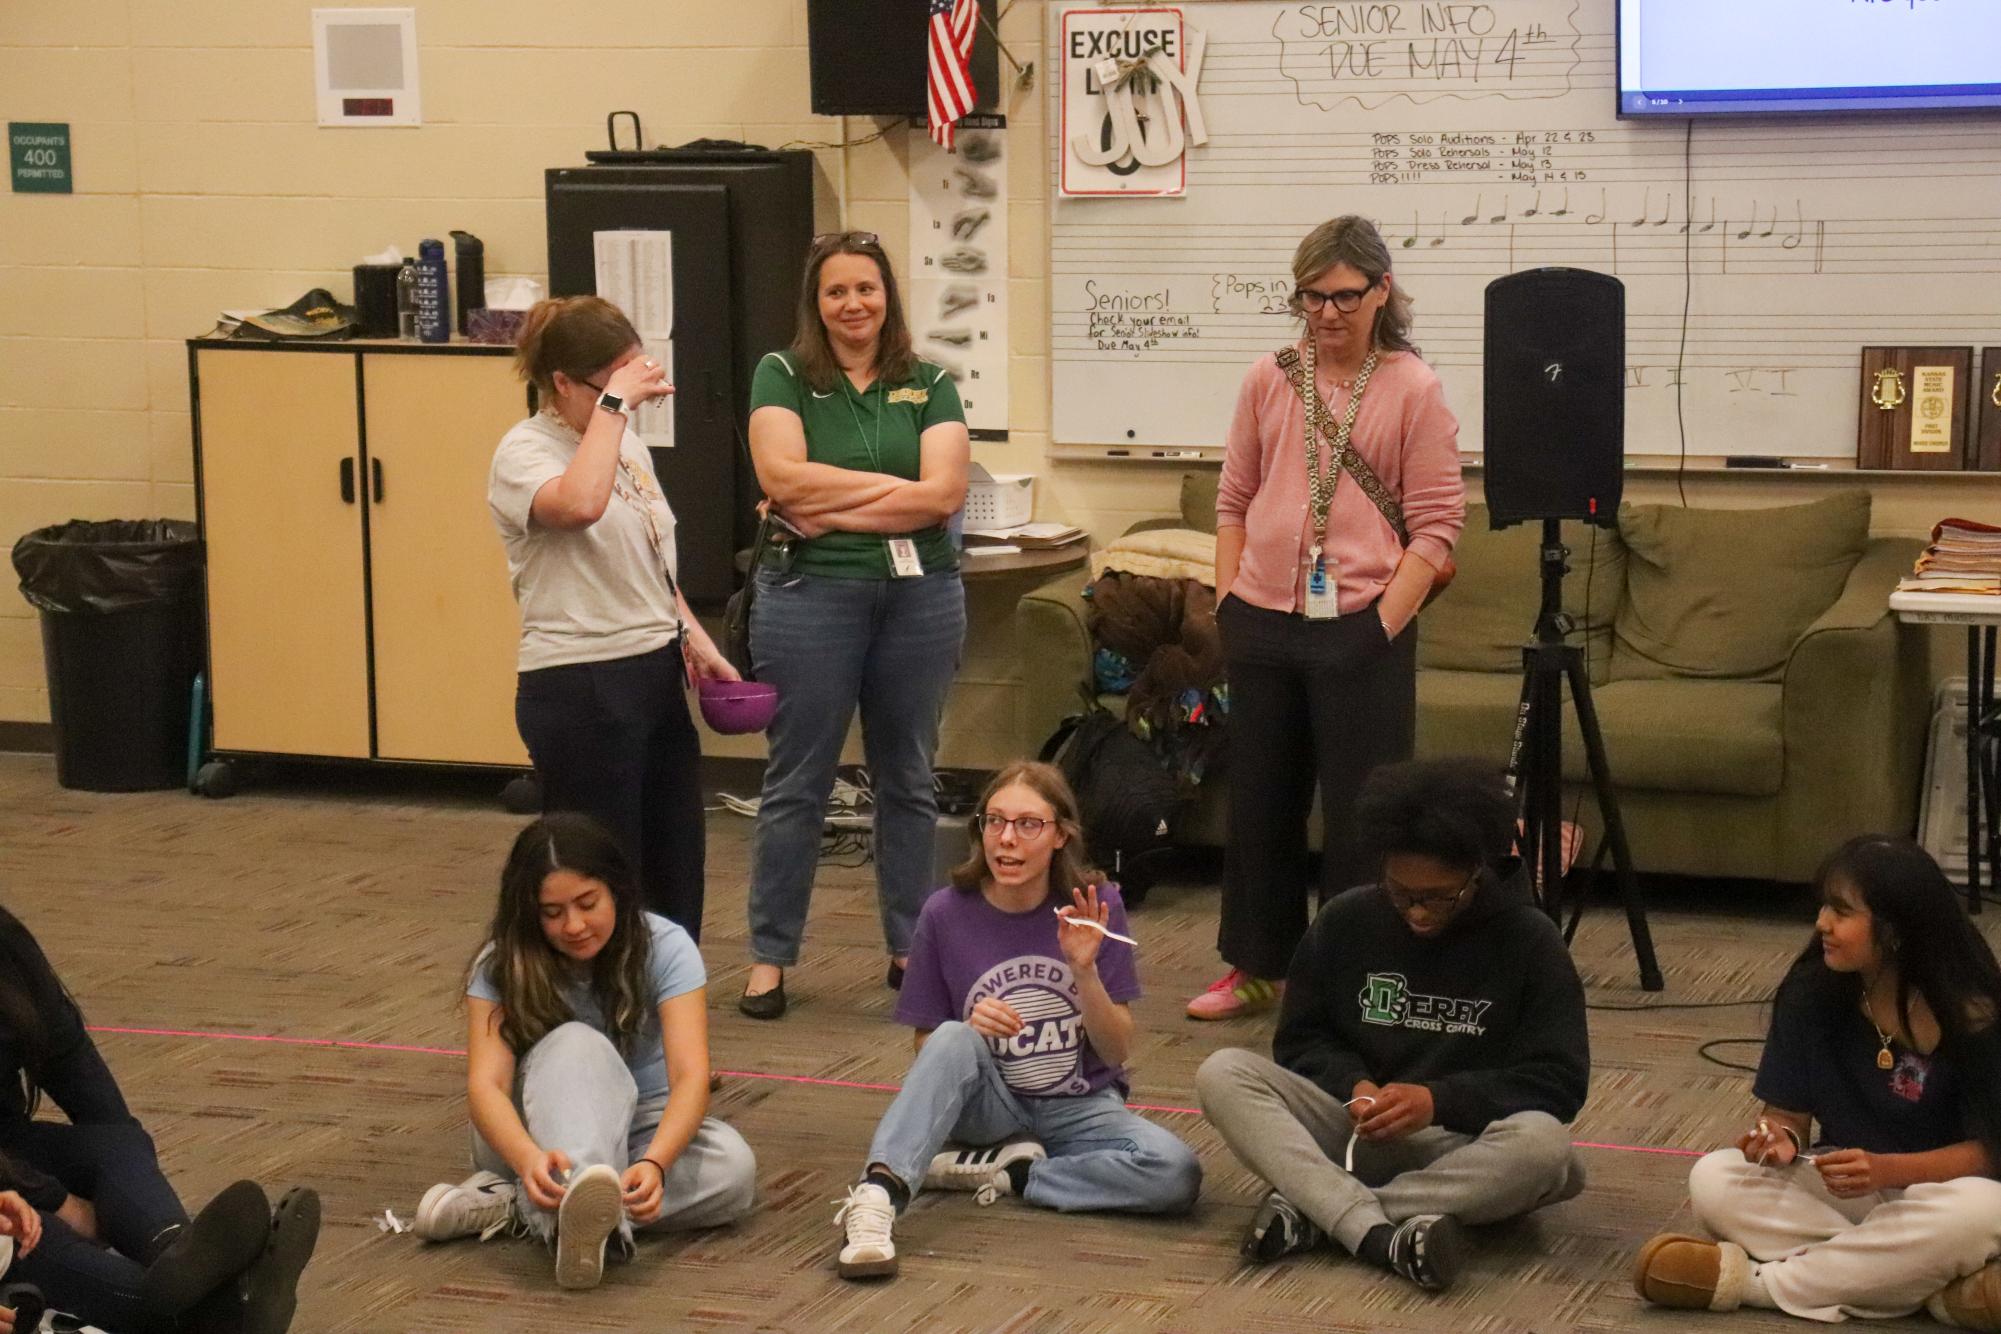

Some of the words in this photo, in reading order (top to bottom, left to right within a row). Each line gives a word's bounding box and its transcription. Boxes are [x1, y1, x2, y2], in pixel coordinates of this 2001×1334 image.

[1300, 5, 1406, 38] SENIOR
[1422, 3, 1496, 36] INFO
[1070, 30, 1176, 59] EXCUSE
[1319, 40, 1388, 80] DUE
[1408, 37, 1484, 82] MAY
[13, 135, 65, 146] OCCUPANTS
[1408, 133, 1434, 145] Solo
[1440, 133, 1496, 145] Auditions
[1515, 132, 1537, 146] Apr
[1544, 131, 1559, 143] 22
[23, 148, 56, 166] 400
[1409, 146, 1433, 158] Solo
[1511, 146, 1536, 158] May
[1407, 159, 1441, 170] Dress
[1511, 158, 1535, 170] May
[17, 168, 65, 179] PERMITTED
[1511, 170, 1537, 187] May
[1225, 274, 1265, 300] Pops
[1270, 280, 1288, 293] in
[1086, 280, 1170, 312] Seniors!
[1090, 312, 1123, 326] Check
[1130, 316, 1156, 328] your
[1159, 314, 1190, 326] email
[1097, 339, 1117, 351] Due
[1121, 339, 1141, 353] May
[1403, 1018, 1443, 1033] CROSS
